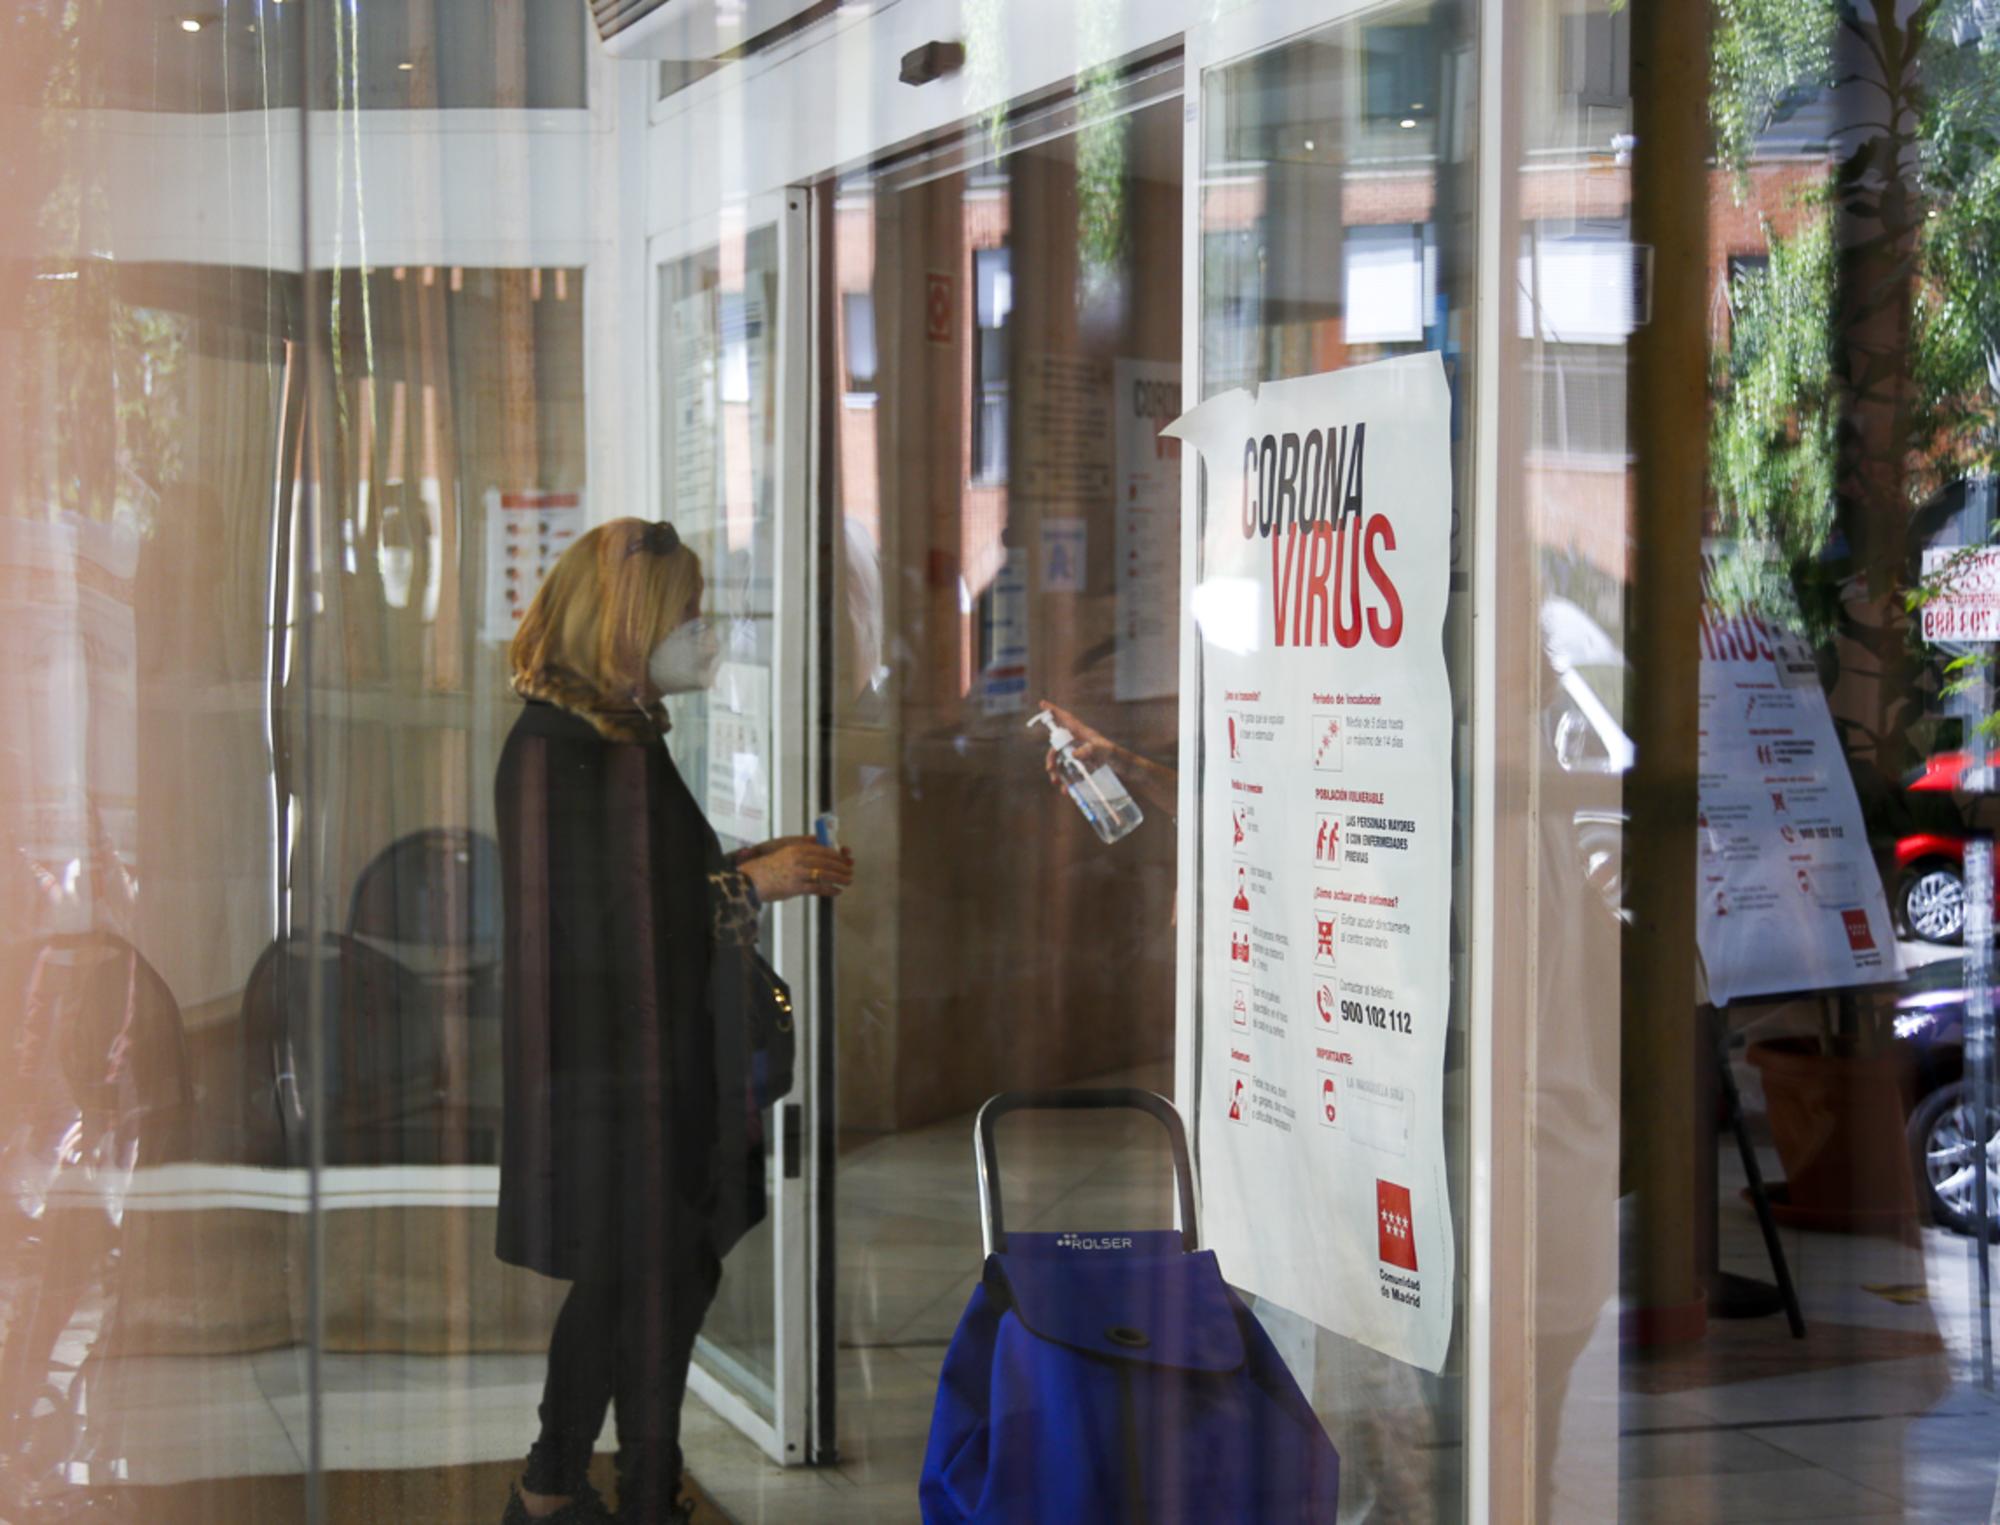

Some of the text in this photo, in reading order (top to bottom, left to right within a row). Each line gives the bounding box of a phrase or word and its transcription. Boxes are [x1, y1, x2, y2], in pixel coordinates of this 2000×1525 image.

[1242, 422, 1366, 539] CORONA
[1272, 512, 1404, 649] VIRUS
[1357, 816, 1387, 831] PERSONAS
[1388, 818, 1415, 833] MAYORES
[1341, 1000, 1412, 1034] 900 102 112
[1072, 1238, 1132, 1250] ROLSER
[1379, 1268, 1420, 1291] Comunidad
[1391, 1287, 1420, 1308] Madrid
